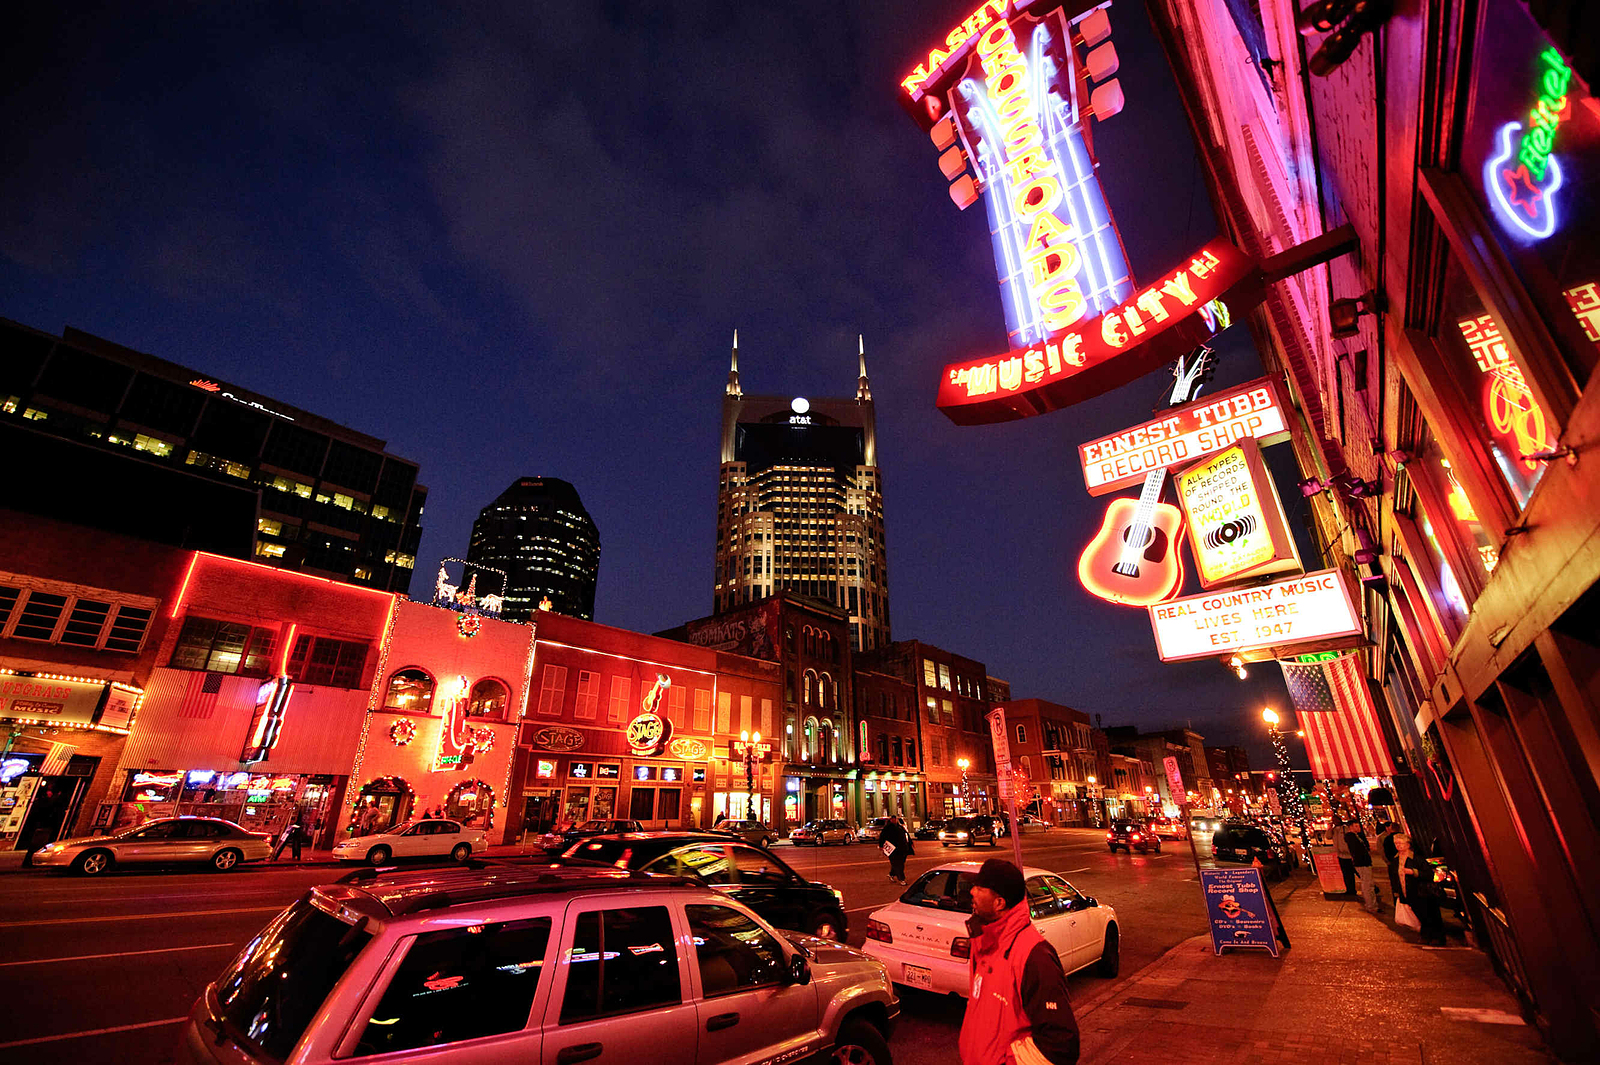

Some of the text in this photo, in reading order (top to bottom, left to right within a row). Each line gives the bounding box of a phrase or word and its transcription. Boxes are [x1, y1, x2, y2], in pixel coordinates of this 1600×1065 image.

[900, 0, 1018, 95] NASHV
[976, 18, 1087, 333] CROSSROADS
[966, 271, 1198, 397] MUSIC CITY
[789, 415, 811, 424] at&t
[1083, 388, 1272, 464] ERNEST TUBB
[1101, 416, 1262, 481] RECORD SHOP
[1185, 461, 1245, 497] OF RECORDS
[1187, 453, 1238, 486] ALL TYPES
[1192, 482, 1248, 514] ROUND THE
[1198, 476, 1238, 501] SHIPPED
[1197, 493, 1251, 526] WORLD
[1157, 577, 1334, 620] REAL COUNTRY MUSIC
[1194, 602, 1299, 630] LIVES HERE
[1209, 621, 1294, 645] EST. 1947
[14, 705, 58, 714] MUSIC
[536, 729, 582, 746] STAGE
[628, 720, 660, 742] STAGE
[671, 742, 706, 755] STAGE
[901, 932, 940, 943] MAXIMA
[1045, 1001, 1058, 1010] HH
